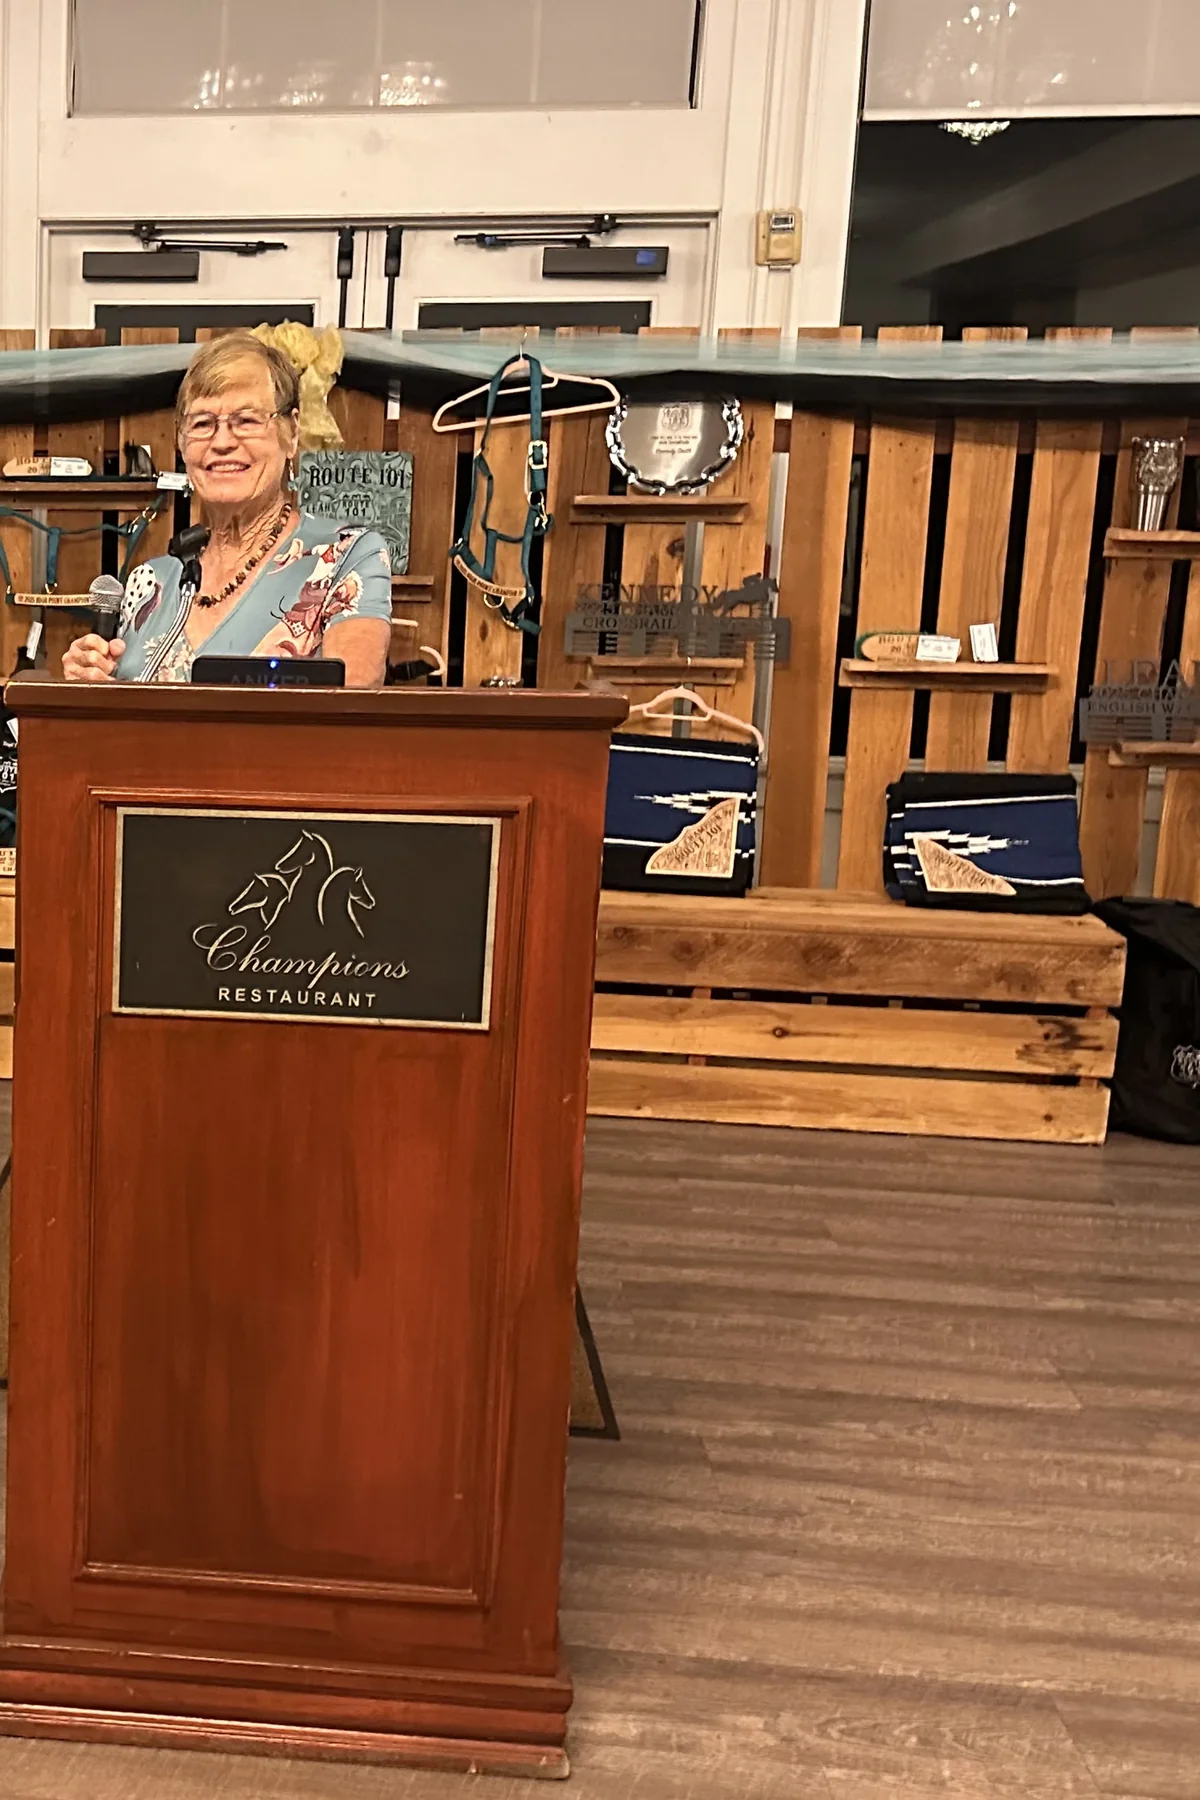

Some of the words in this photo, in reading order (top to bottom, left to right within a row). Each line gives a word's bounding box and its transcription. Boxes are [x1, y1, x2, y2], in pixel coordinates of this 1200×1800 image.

[309, 466, 373, 487] ROUTE
[379, 467, 405, 489] 101
[345, 507, 366, 517] 101
[576, 583, 719, 604] KENNEDY
[193, 924, 410, 989] Champions
[218, 986, 377, 1008] RESTAURANT
